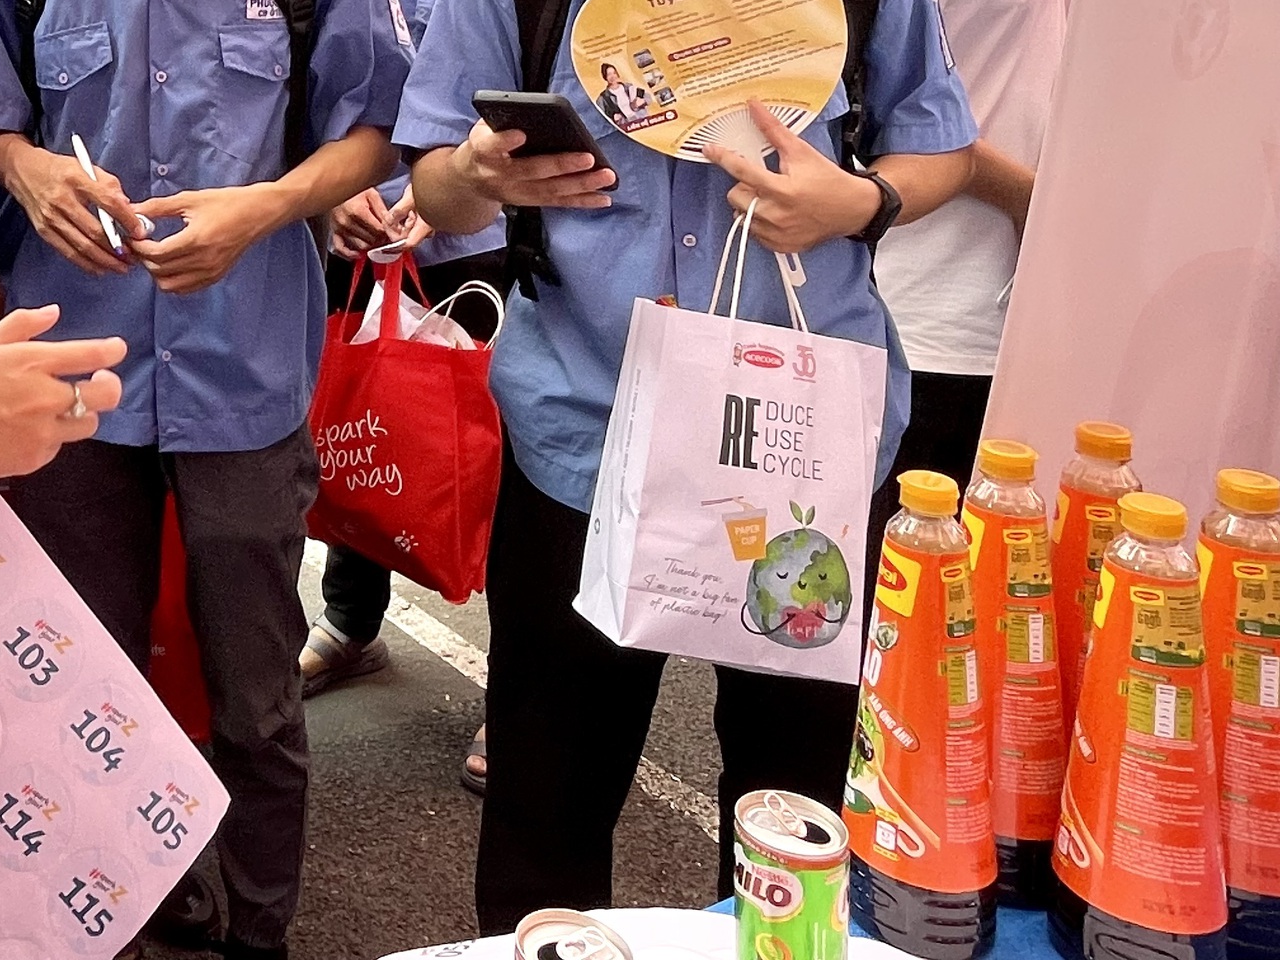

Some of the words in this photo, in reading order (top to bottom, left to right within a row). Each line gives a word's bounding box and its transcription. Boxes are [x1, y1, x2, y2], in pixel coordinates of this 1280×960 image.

[315, 409, 388, 454] spark
[719, 393, 761, 470] RE
[765, 400, 815, 428] DUCE
[764, 427, 804, 452] USE
[320, 444, 377, 481] your
[346, 463, 404, 496] way
[762, 453, 825, 482] CYCLE
[664, 557, 700, 579] Thank
[650, 597, 663, 611] of
[2, 626, 60, 686] 103
[70, 709, 125, 773] 104
[137, 791, 189, 850] 105
[59, 877, 114, 937] 115
